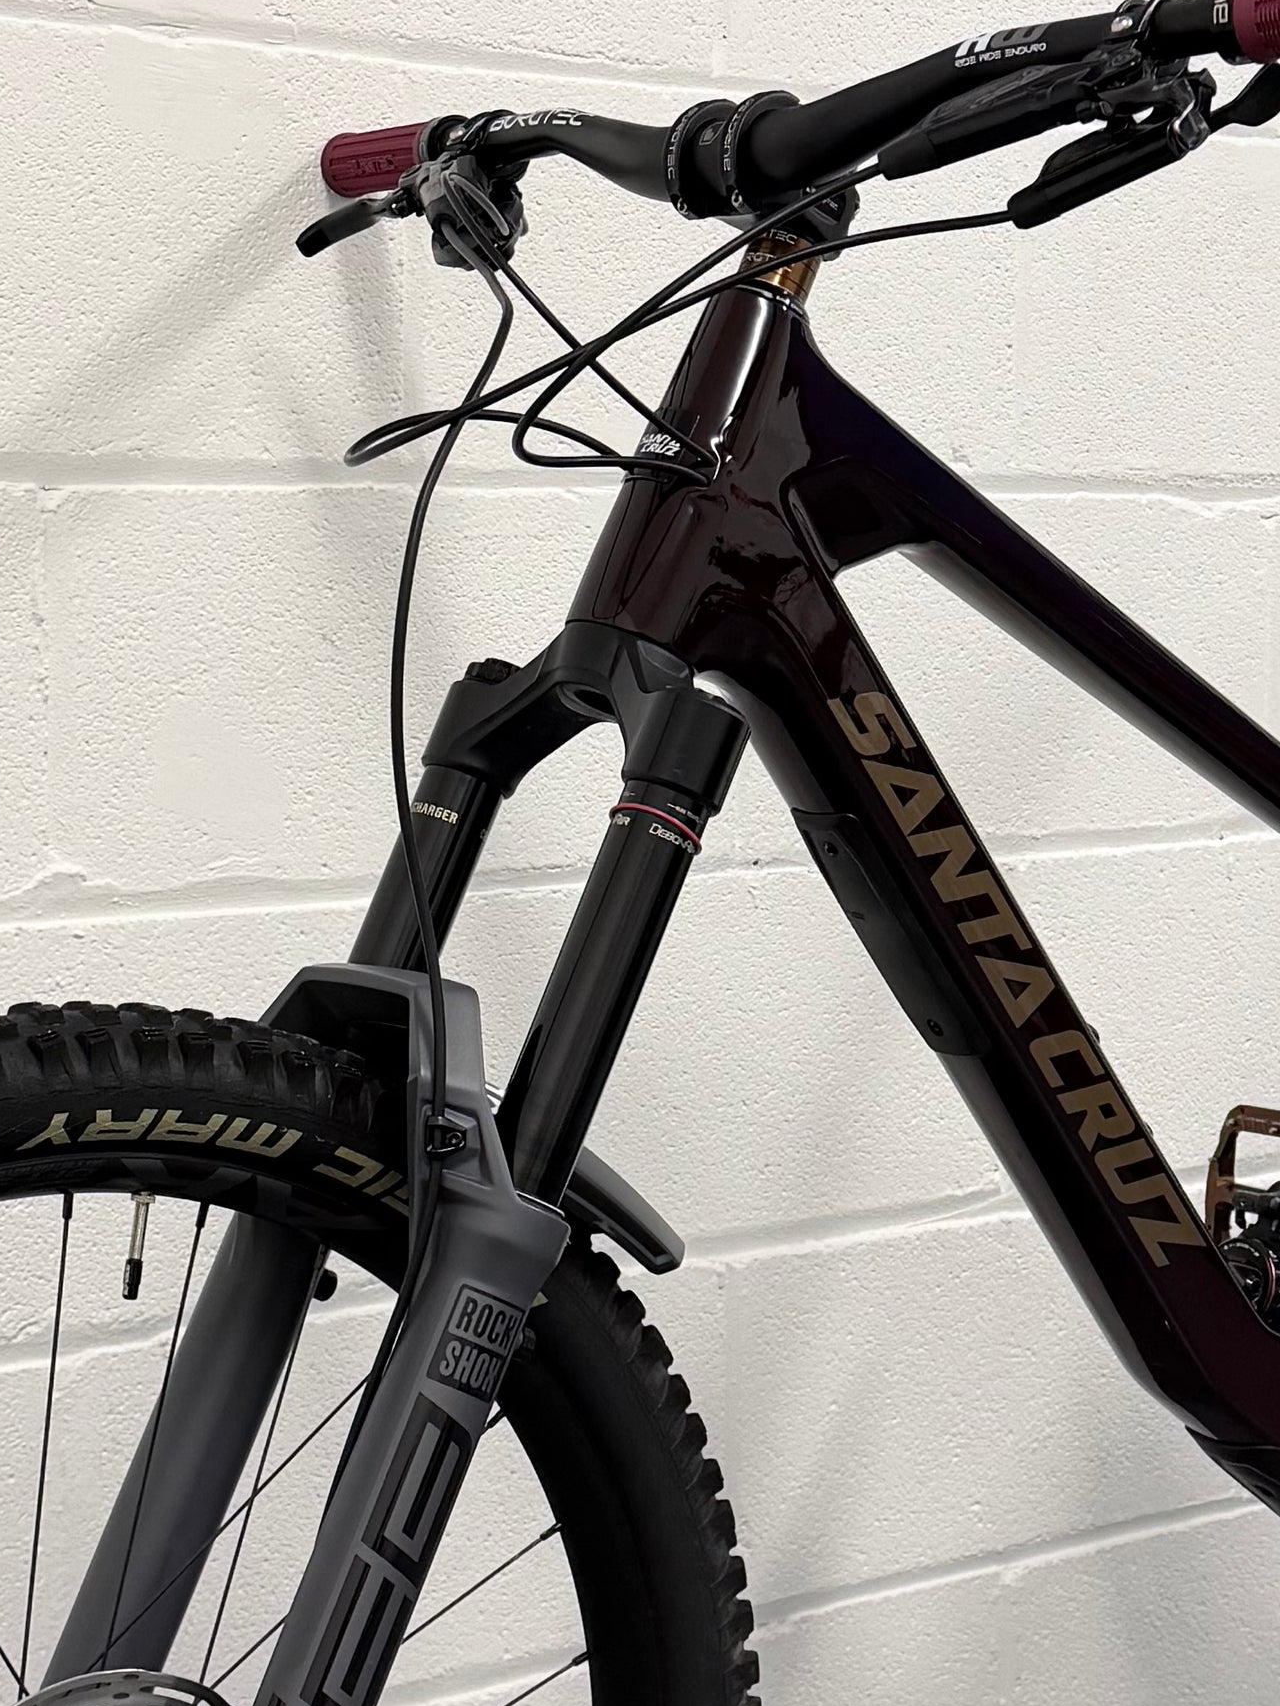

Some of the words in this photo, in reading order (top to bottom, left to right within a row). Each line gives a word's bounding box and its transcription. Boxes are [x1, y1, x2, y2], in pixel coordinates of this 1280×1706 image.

[826, 690, 1057, 1030] SANTA
[1029, 1029, 1208, 1268] CRUZ
[16, 1106, 305, 1159] MARY
[455, 1295, 519, 1351] ROCK
[439, 1340, 503, 1394] SHOX
